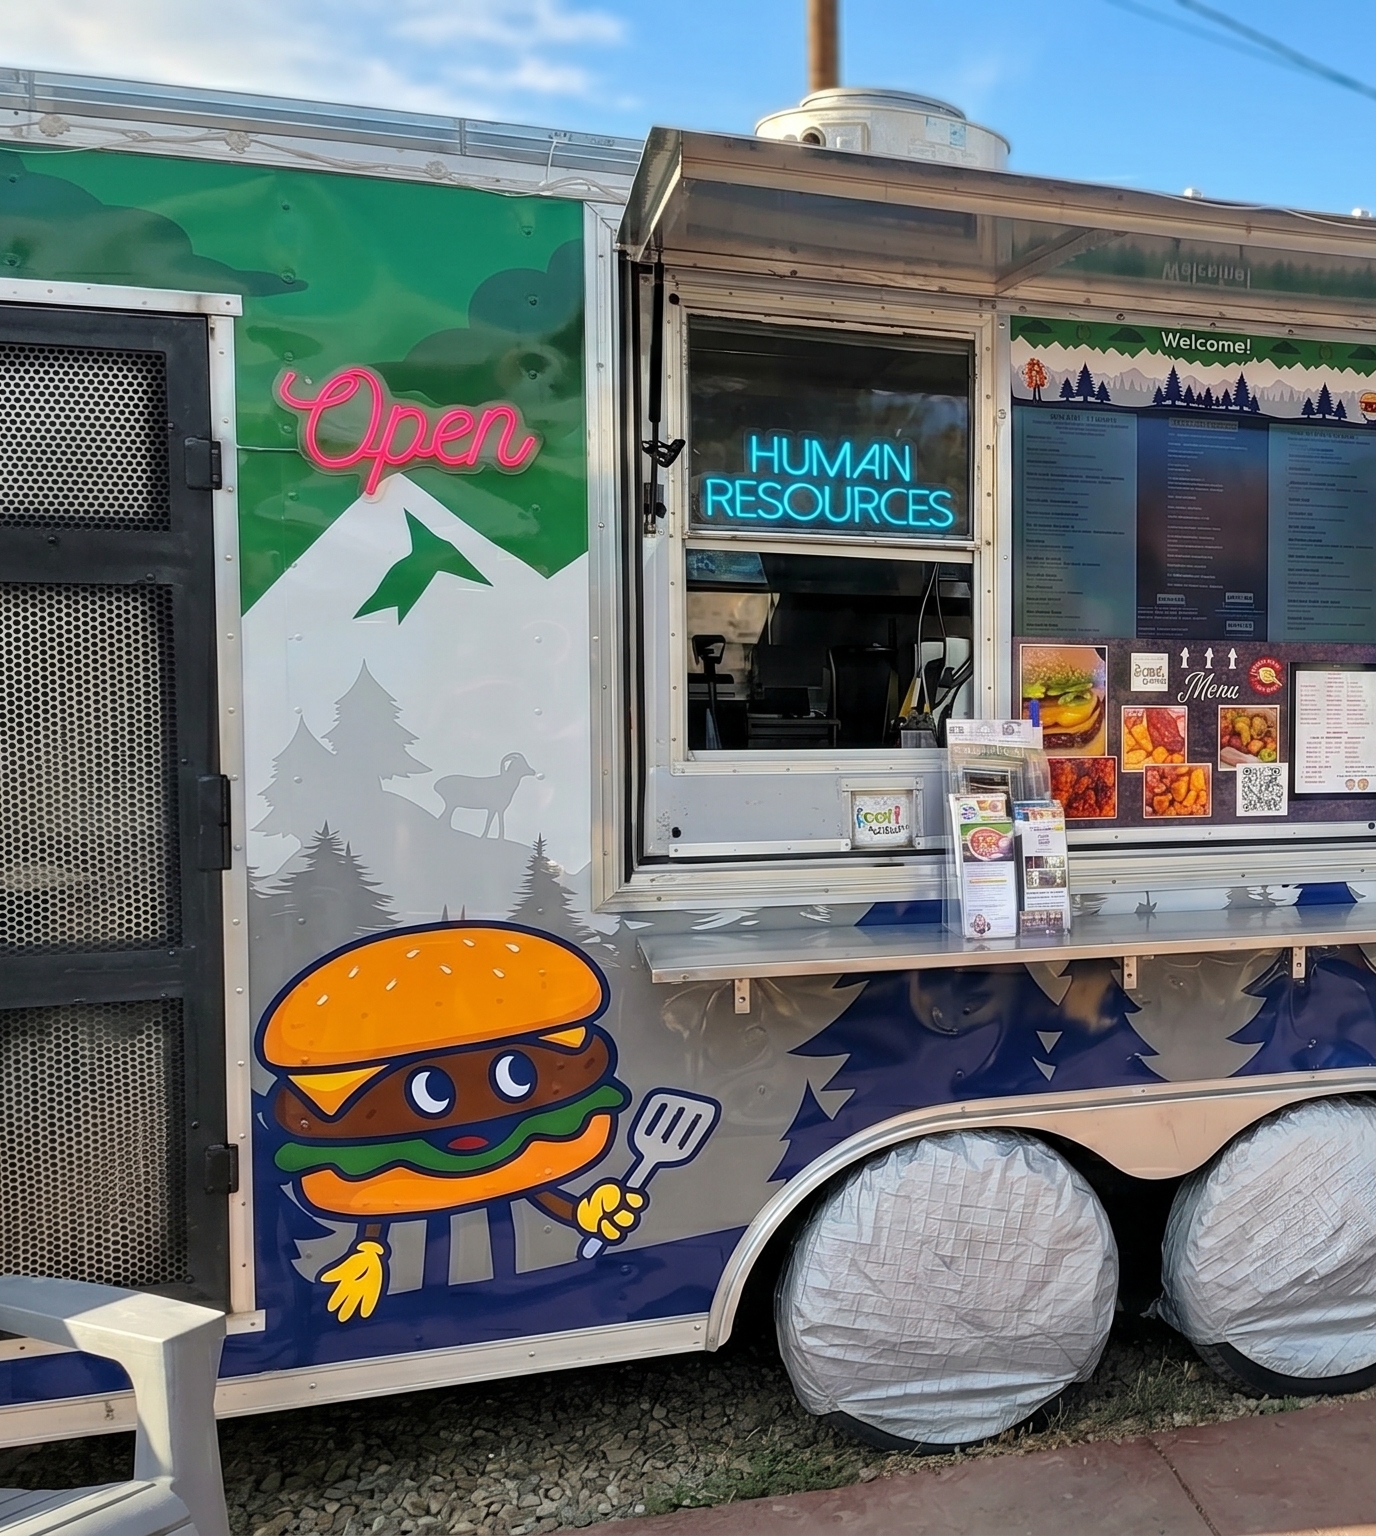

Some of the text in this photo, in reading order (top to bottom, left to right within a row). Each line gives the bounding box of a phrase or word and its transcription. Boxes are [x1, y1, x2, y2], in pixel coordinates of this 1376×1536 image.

[1161, 331, 1251, 354] Welcome!
[278, 367, 536, 496] Open
[751, 435, 911, 482] HUMAN
[705, 479, 954, 527] RESOURCES
[1177, 671, 1240, 703] Menu
